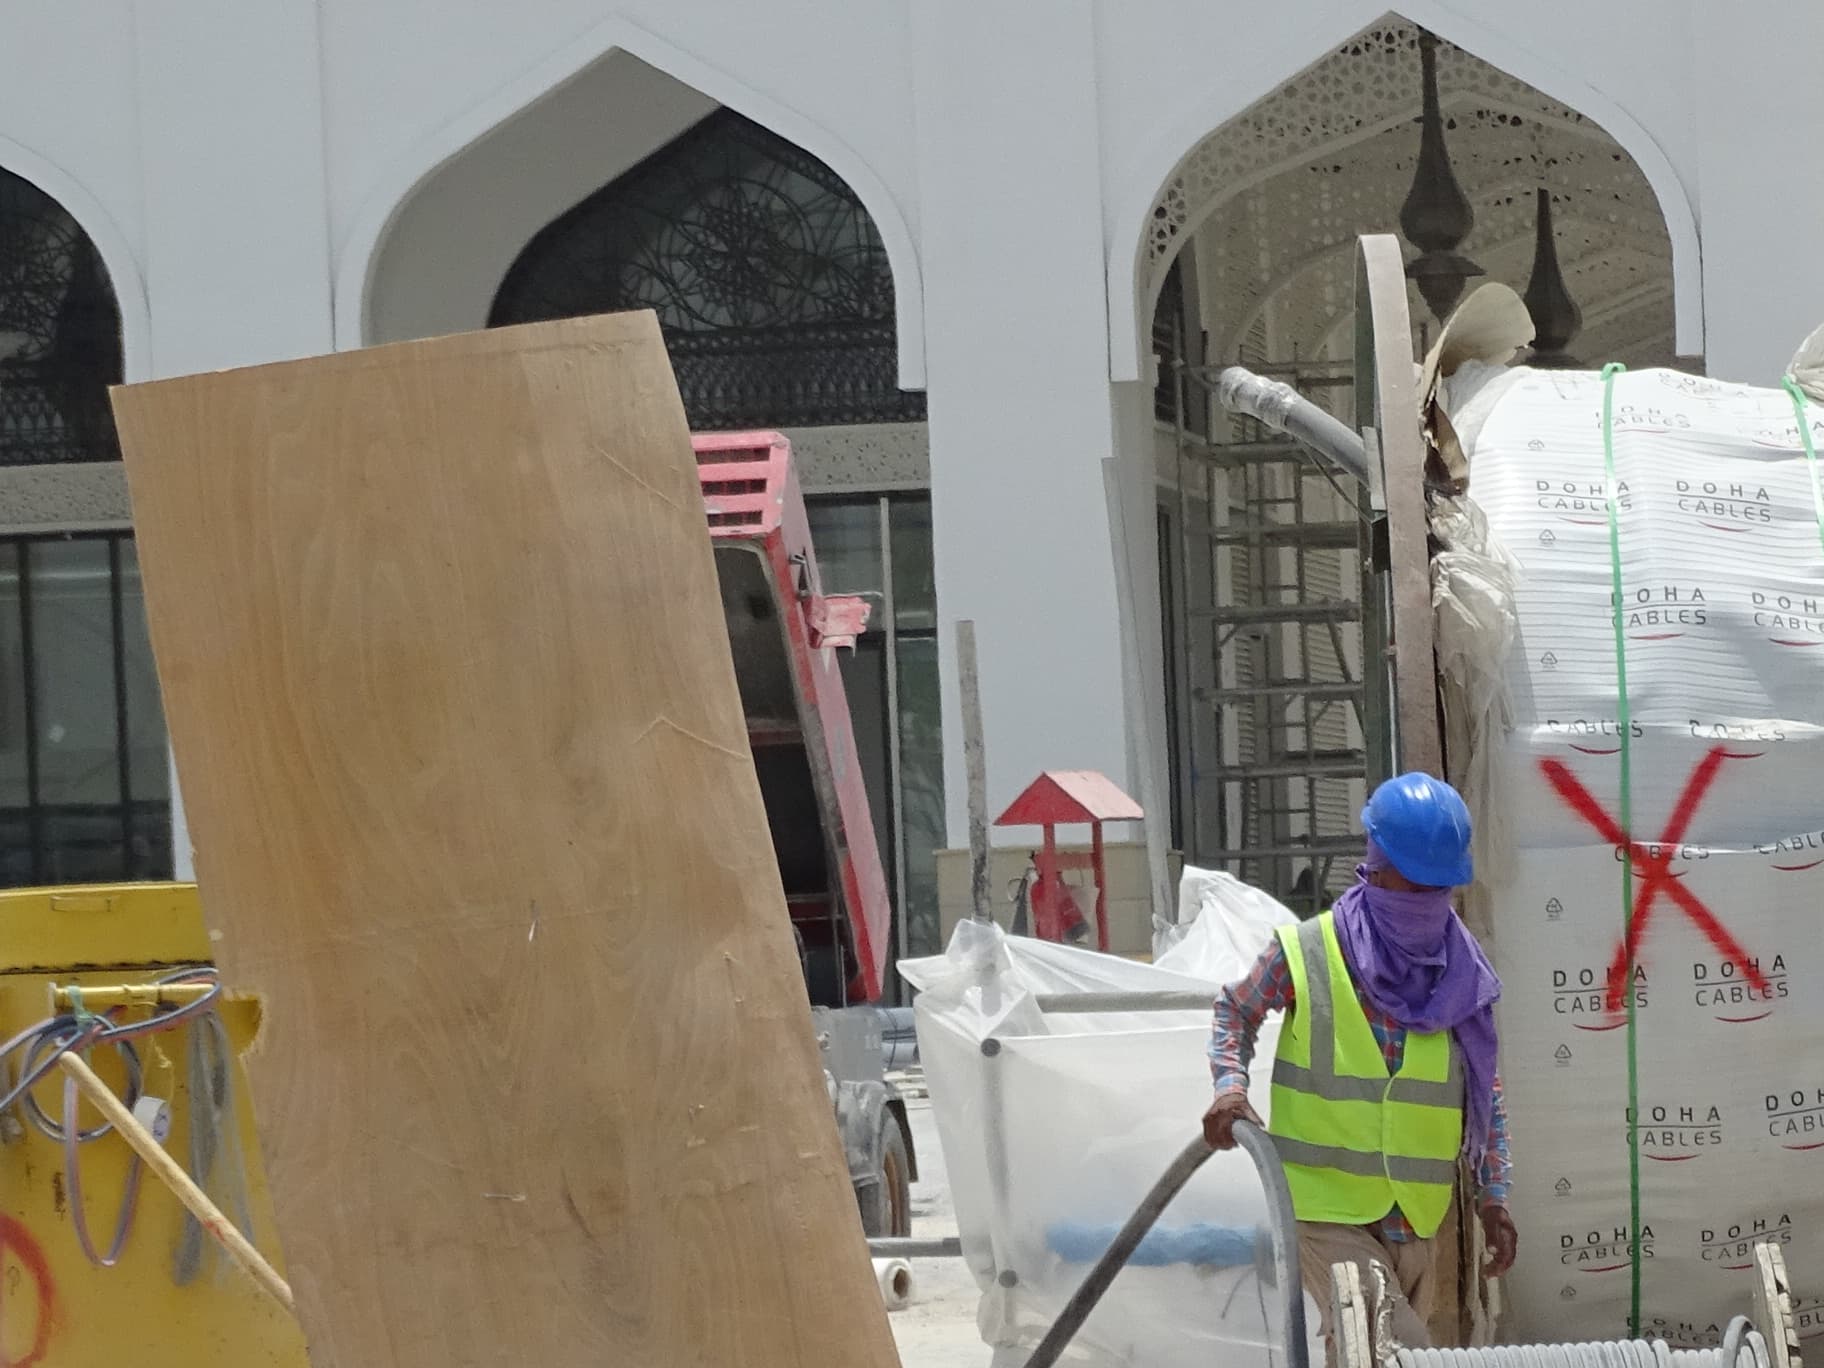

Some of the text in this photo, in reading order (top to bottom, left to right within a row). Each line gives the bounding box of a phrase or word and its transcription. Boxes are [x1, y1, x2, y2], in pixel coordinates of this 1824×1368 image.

[1536, 480, 1630, 496] DOHA
[1676, 480, 1770, 500] DOHA
[1678, 499, 1771, 522] CABLES
[1694, 954, 1786, 980] DOHA
[1695, 982, 1789, 1007] CABLES
[1561, 1225, 1654, 1248] DOHA
[1701, 1214, 1792, 1242] DOHA
